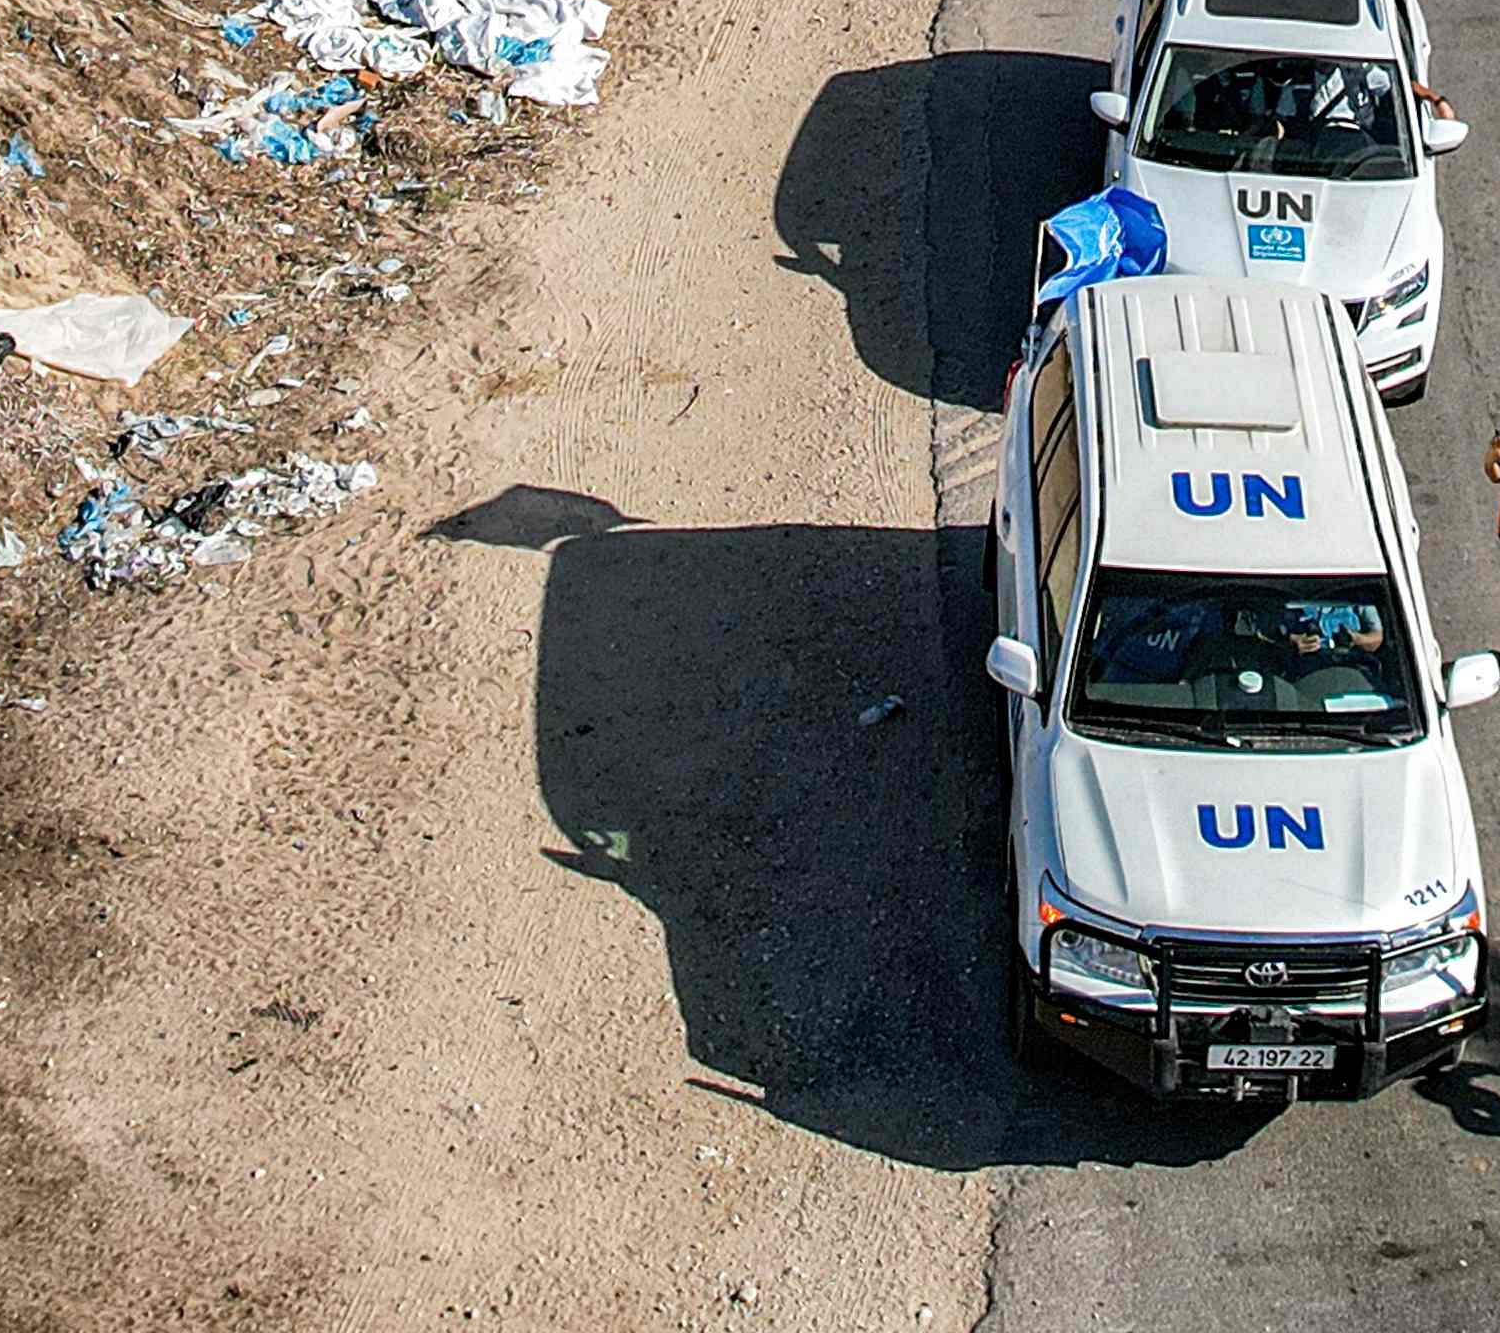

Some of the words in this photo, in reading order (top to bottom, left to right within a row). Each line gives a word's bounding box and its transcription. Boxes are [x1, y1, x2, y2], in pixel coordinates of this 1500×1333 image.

[1237, 188, 1313, 222] UN
[1171, 471, 1306, 520] UN
[1147, 629, 1180, 651] UN
[1196, 804, 1325, 850] UN
